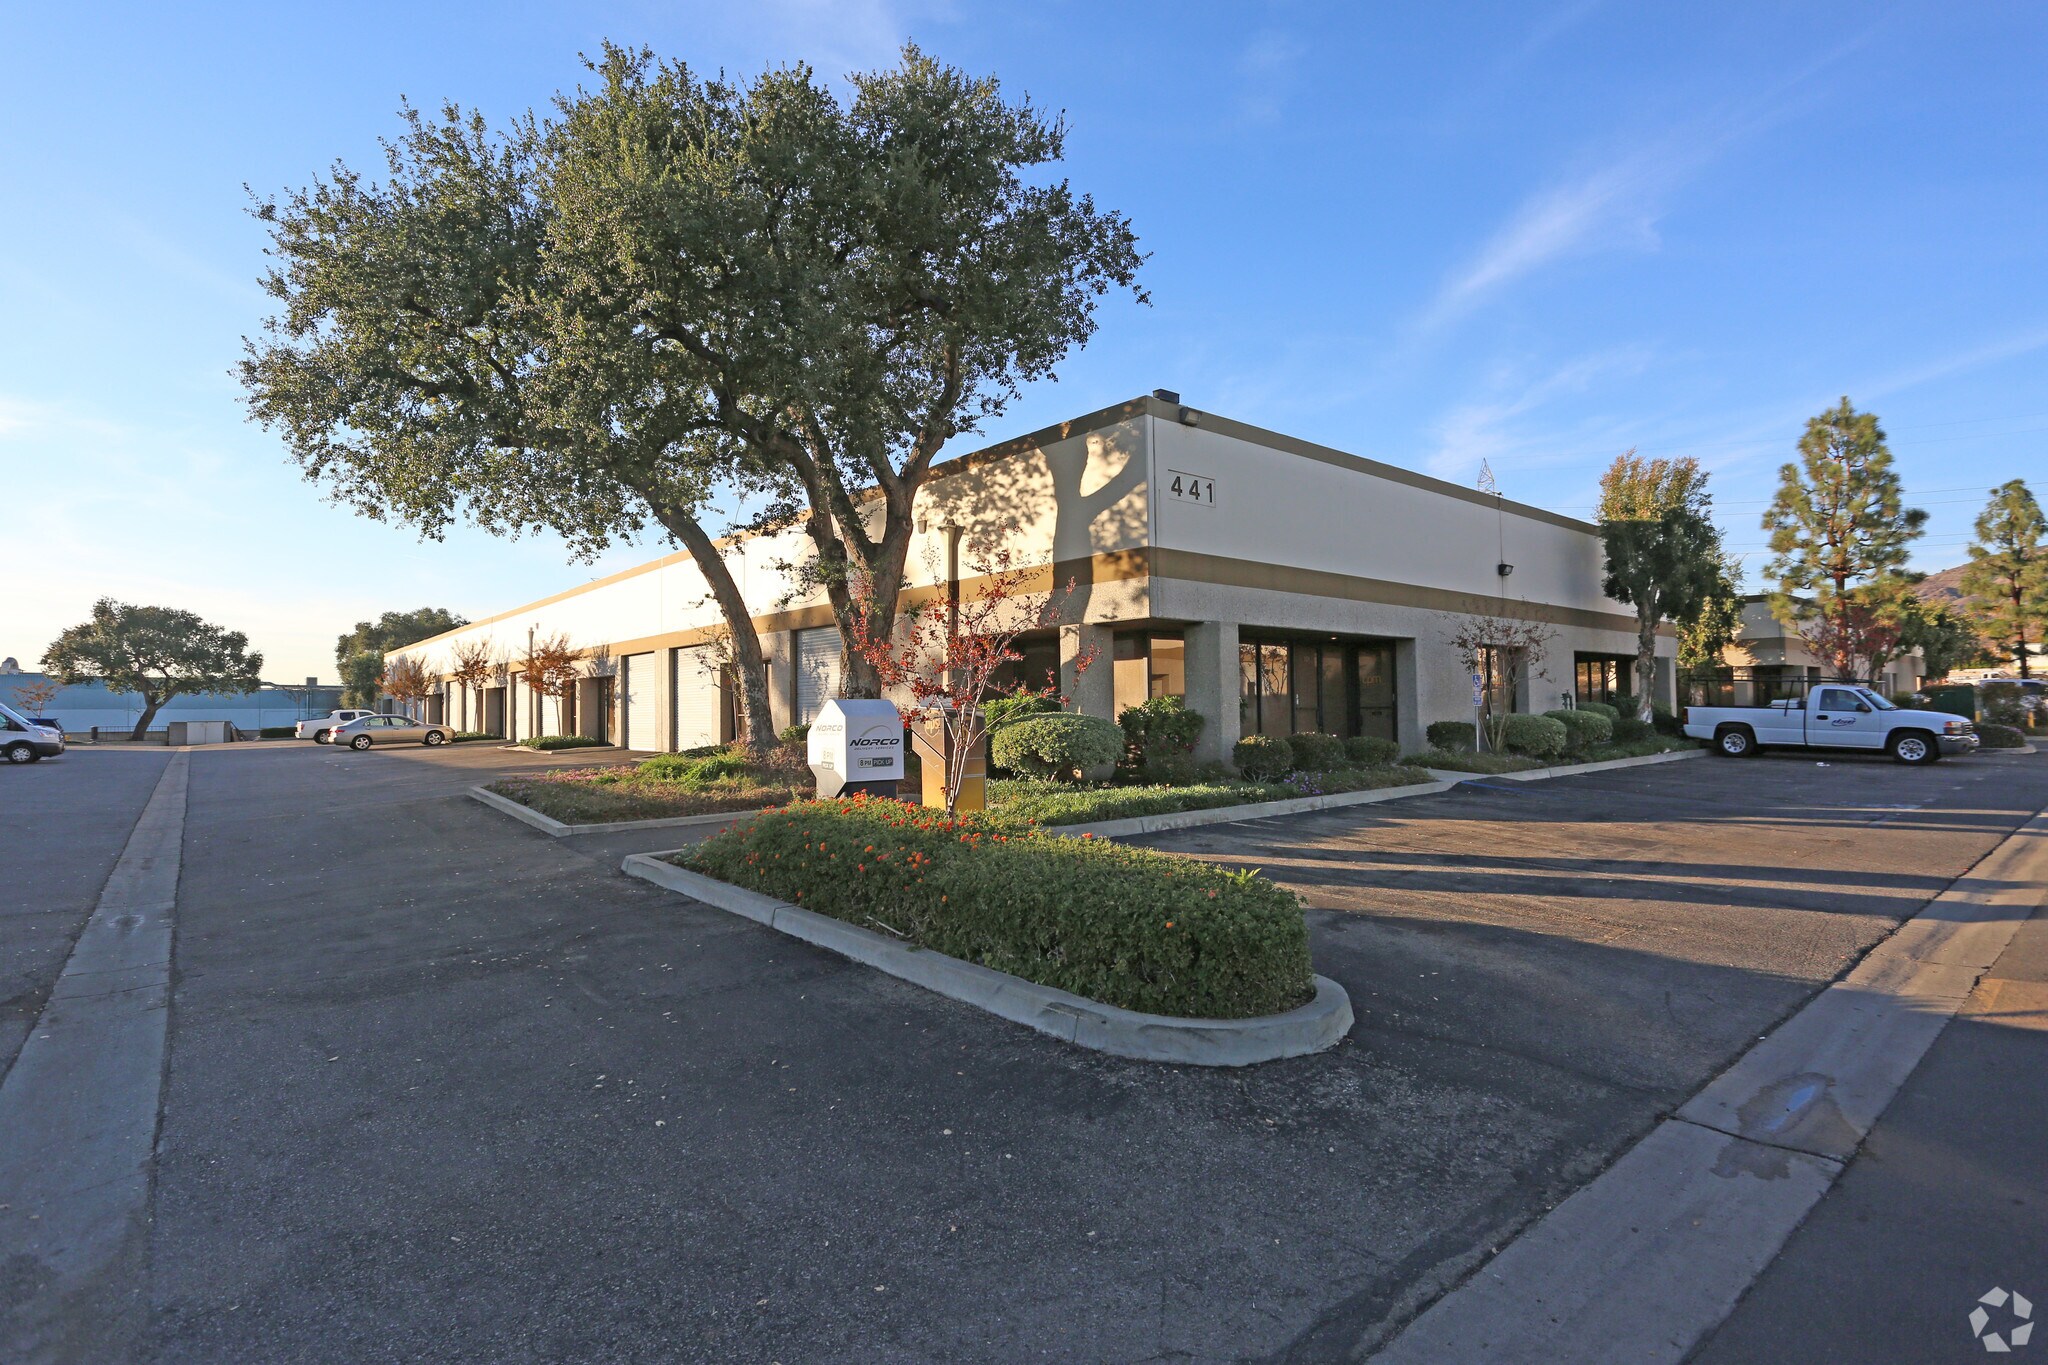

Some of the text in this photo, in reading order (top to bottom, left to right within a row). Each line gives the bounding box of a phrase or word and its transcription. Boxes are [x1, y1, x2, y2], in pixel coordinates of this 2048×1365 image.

[1171, 476, 1213, 503] 441
[925, 719, 940, 734] ups
[850, 738, 900, 746] NORCO
